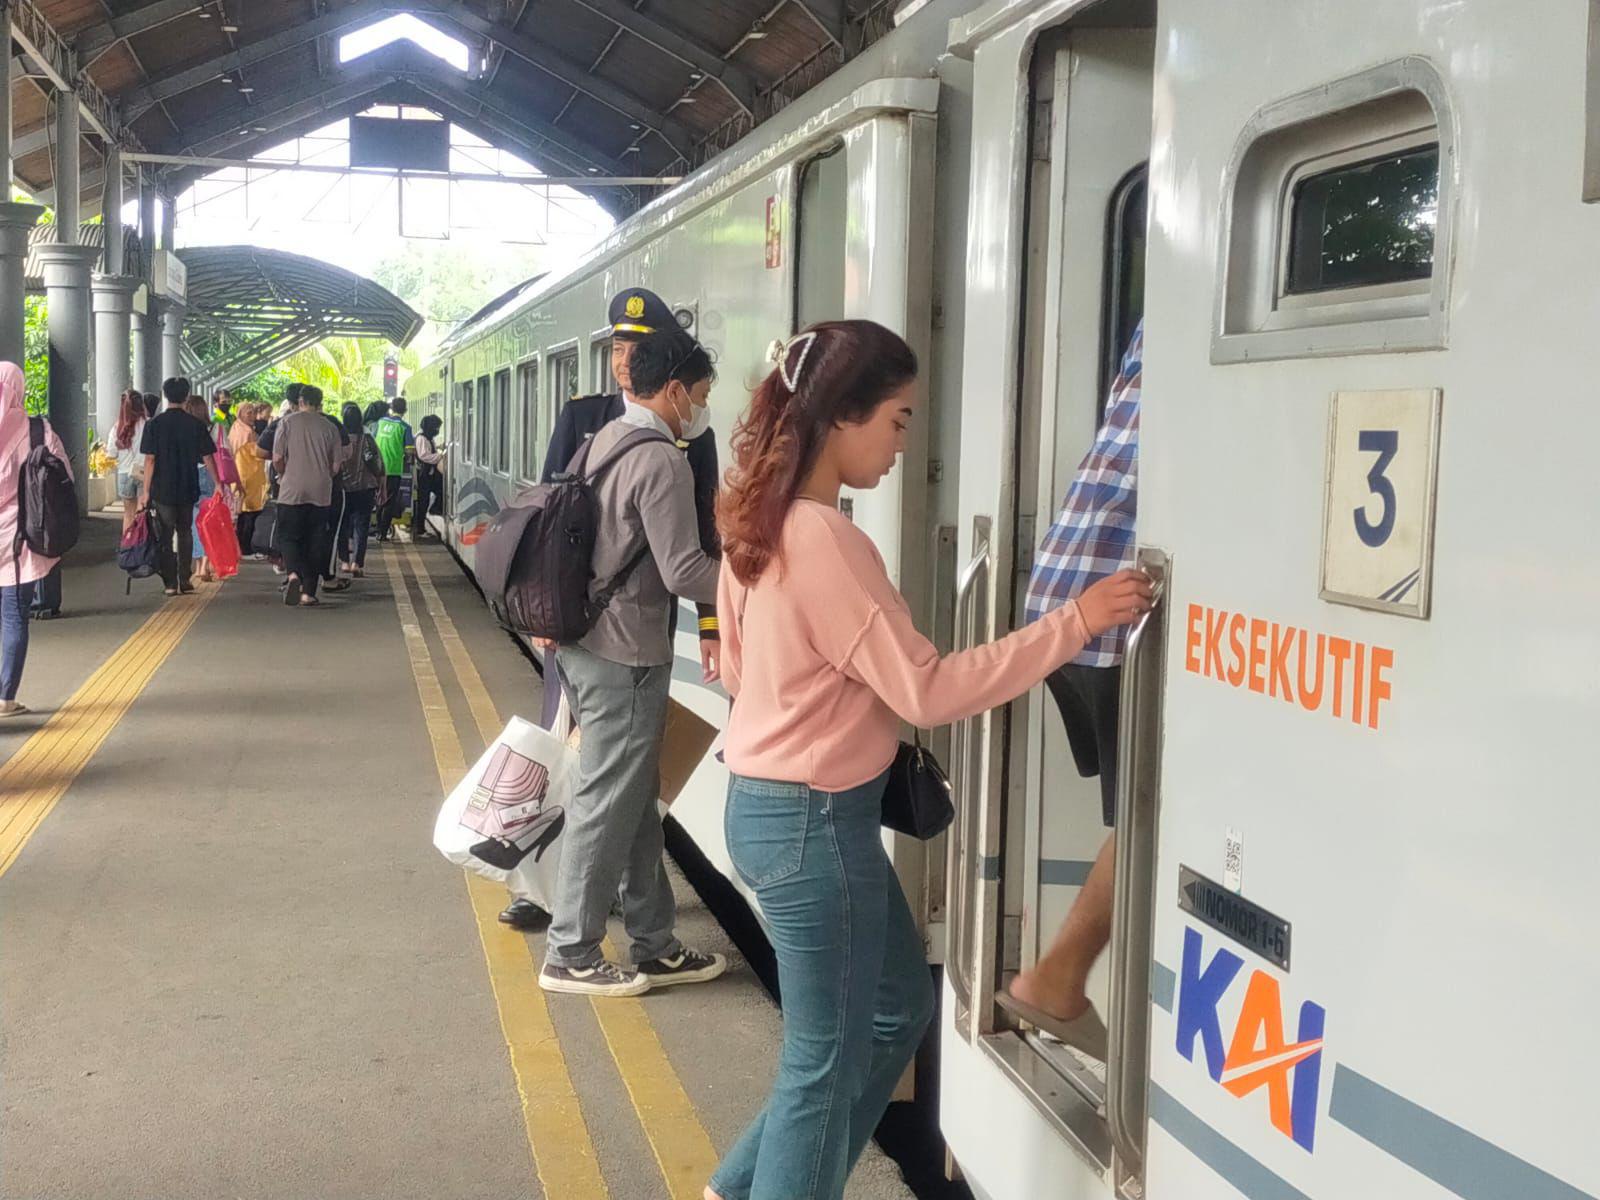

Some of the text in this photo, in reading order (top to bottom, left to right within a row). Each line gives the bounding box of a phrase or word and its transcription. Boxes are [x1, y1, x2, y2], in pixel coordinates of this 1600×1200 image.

[1354, 430, 1399, 548] 3
[1186, 603, 1393, 730] EKSEKUTIF
[1205, 886, 1258, 943] NOMOR
[1176, 925, 1325, 1155] KAI
